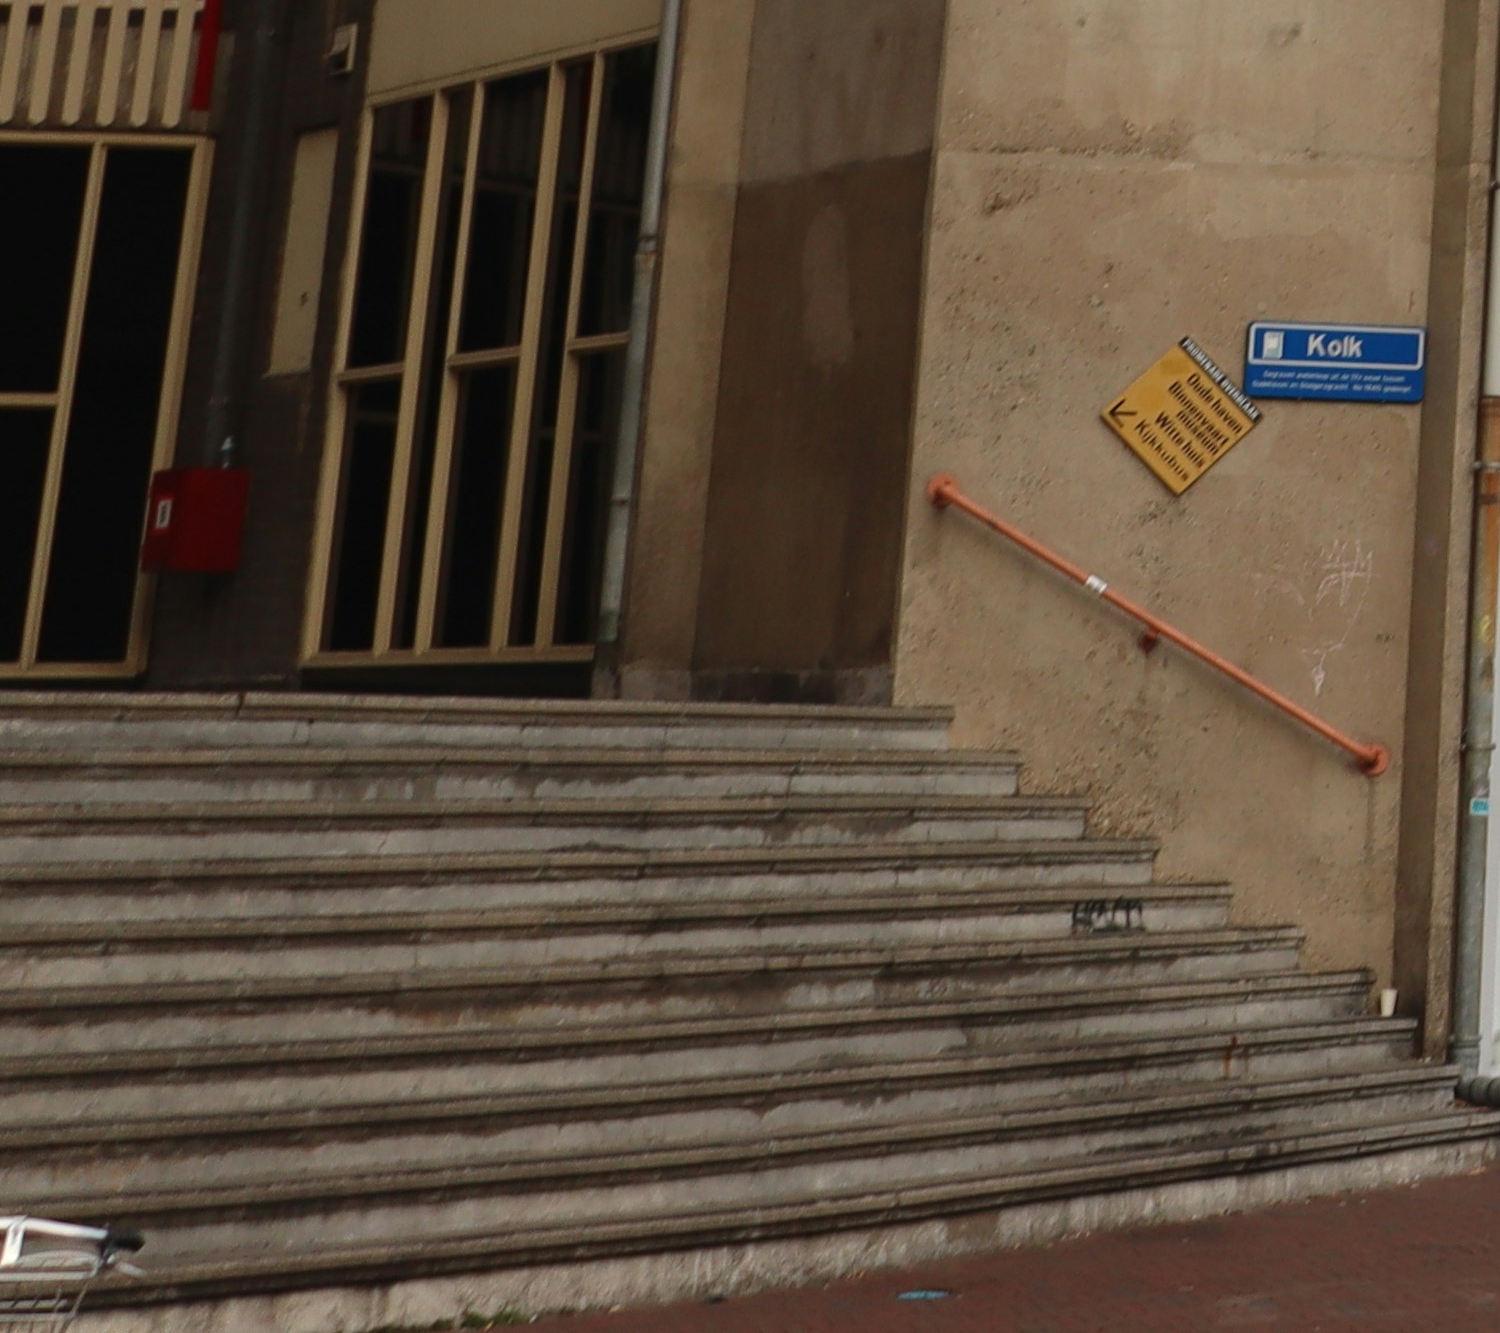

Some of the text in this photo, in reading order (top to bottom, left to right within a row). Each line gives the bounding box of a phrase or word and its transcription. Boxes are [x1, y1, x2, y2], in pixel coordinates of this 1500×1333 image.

[1307, 334, 1363, 358] Kolk
[1168, 380, 1230, 446] Binnenvaart
[1175, 409, 1220, 456] museum
[1186, 372, 1243, 434] Oude haven
[1135, 419, 1189, 482] Kijkkubus
[1155, 411, 1206, 468] Witte huis
